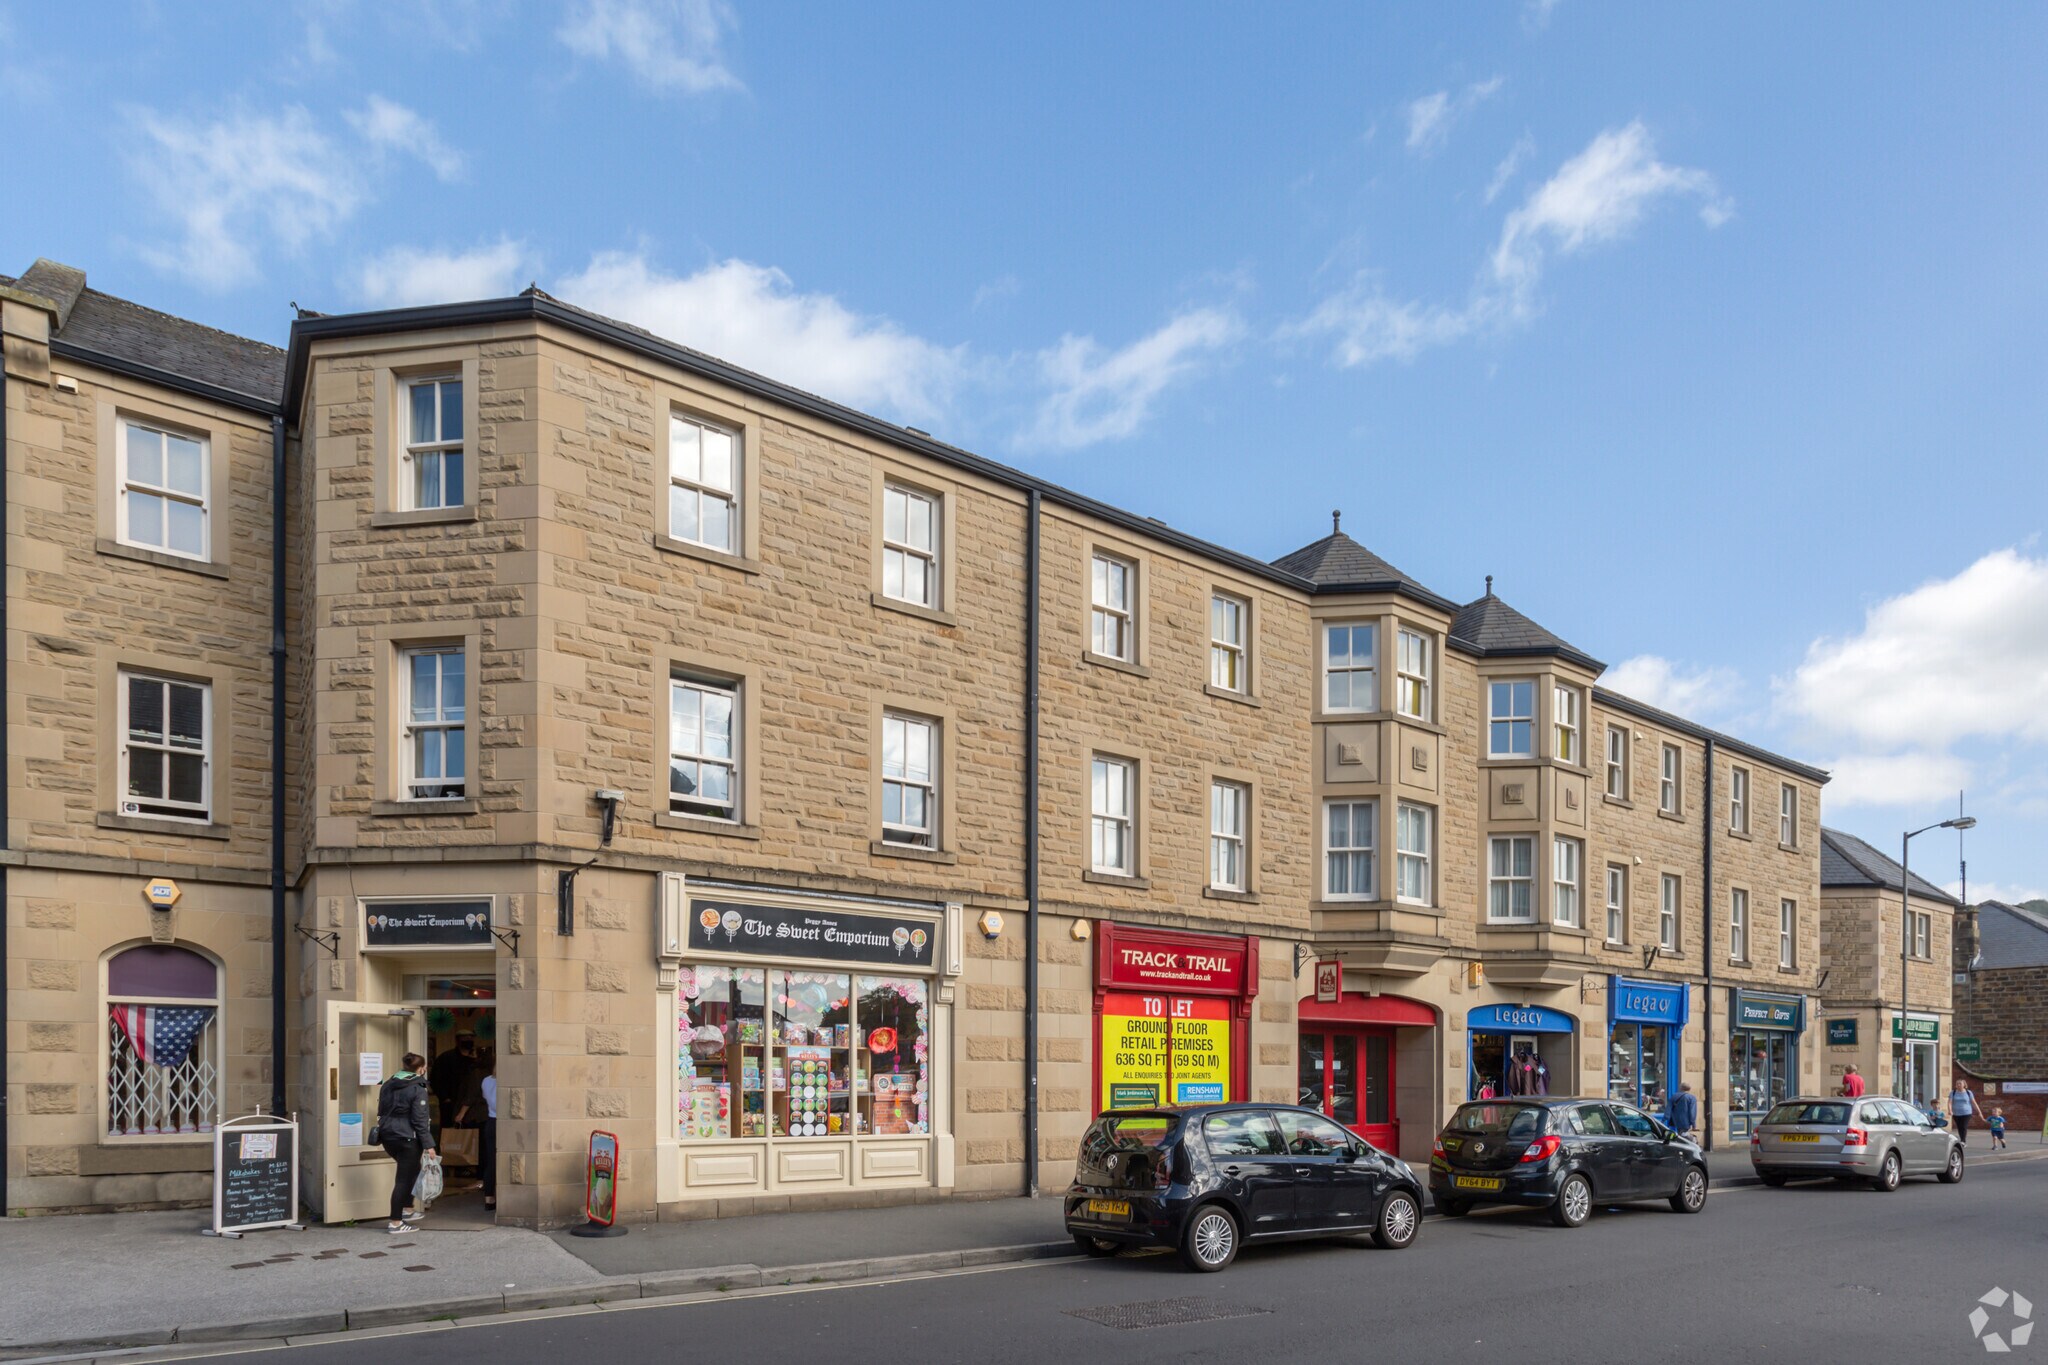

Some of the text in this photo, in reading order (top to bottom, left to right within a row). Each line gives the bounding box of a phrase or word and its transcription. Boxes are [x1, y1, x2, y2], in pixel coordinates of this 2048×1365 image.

[388, 918, 465, 928] The Sweet Emporium
[744, 918, 890, 946] The Sweet Emporium
[1121, 949, 1178, 968] TRACK
[1186, 954, 1231, 972] TRAIL
[1140, 970, 1211, 981] www.trackandtrail.co.uk
[1143, 998, 1193, 1017] TO LET
[1626, 992, 1671, 1015] Legacy
[1495, 1008, 1542, 1026] Legacy
[1128, 1020, 1208, 1035] GROUND FLOOR
[1121, 1036, 1214, 1050] RETAIL PREMISES
[1116, 1053, 1220, 1069] 636 SQ FT (59 SQ M)
[1460, 1176, 1496, 1188] DY64 BYT
